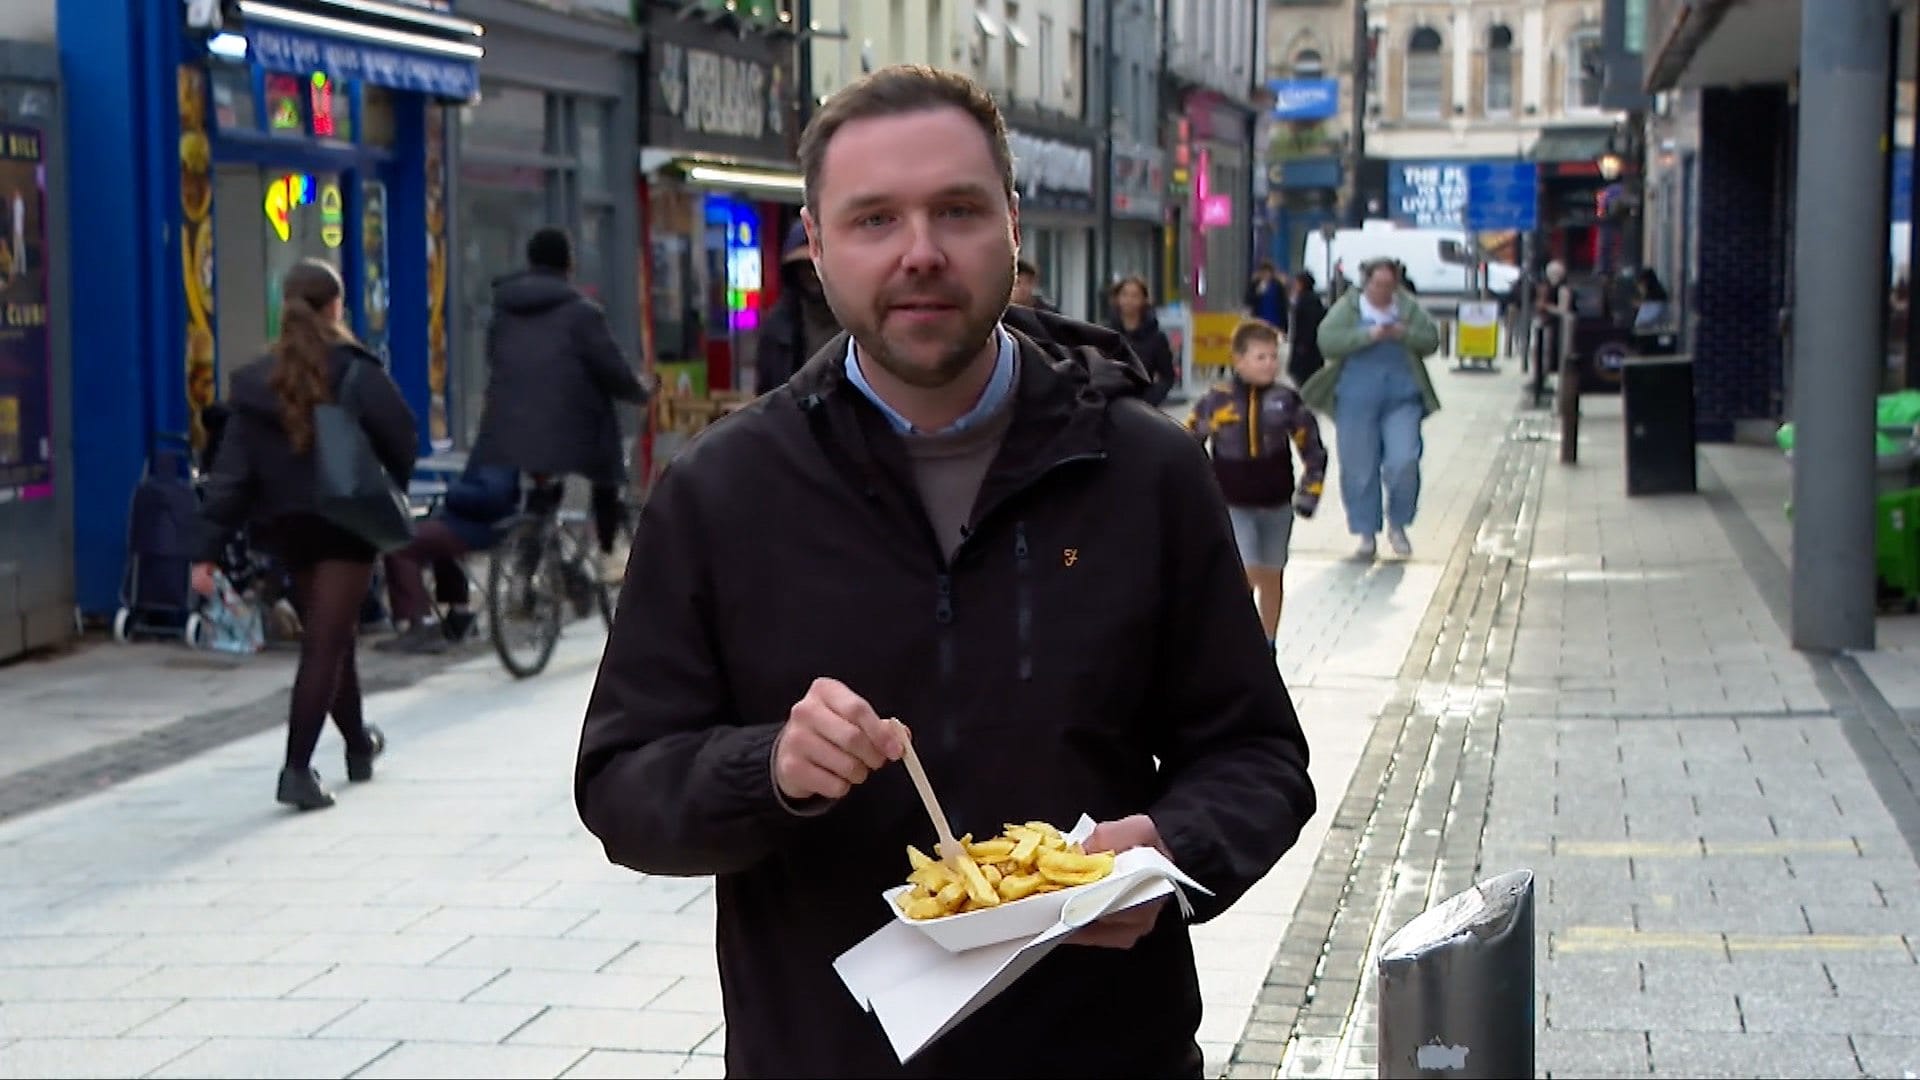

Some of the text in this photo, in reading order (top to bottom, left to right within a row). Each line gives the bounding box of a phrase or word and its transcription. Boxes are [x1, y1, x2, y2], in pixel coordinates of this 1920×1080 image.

[1403, 166, 1465, 186] THE PL
[1438, 185, 1466, 198] WA
[1402, 196, 1465, 212] LIVE SP
